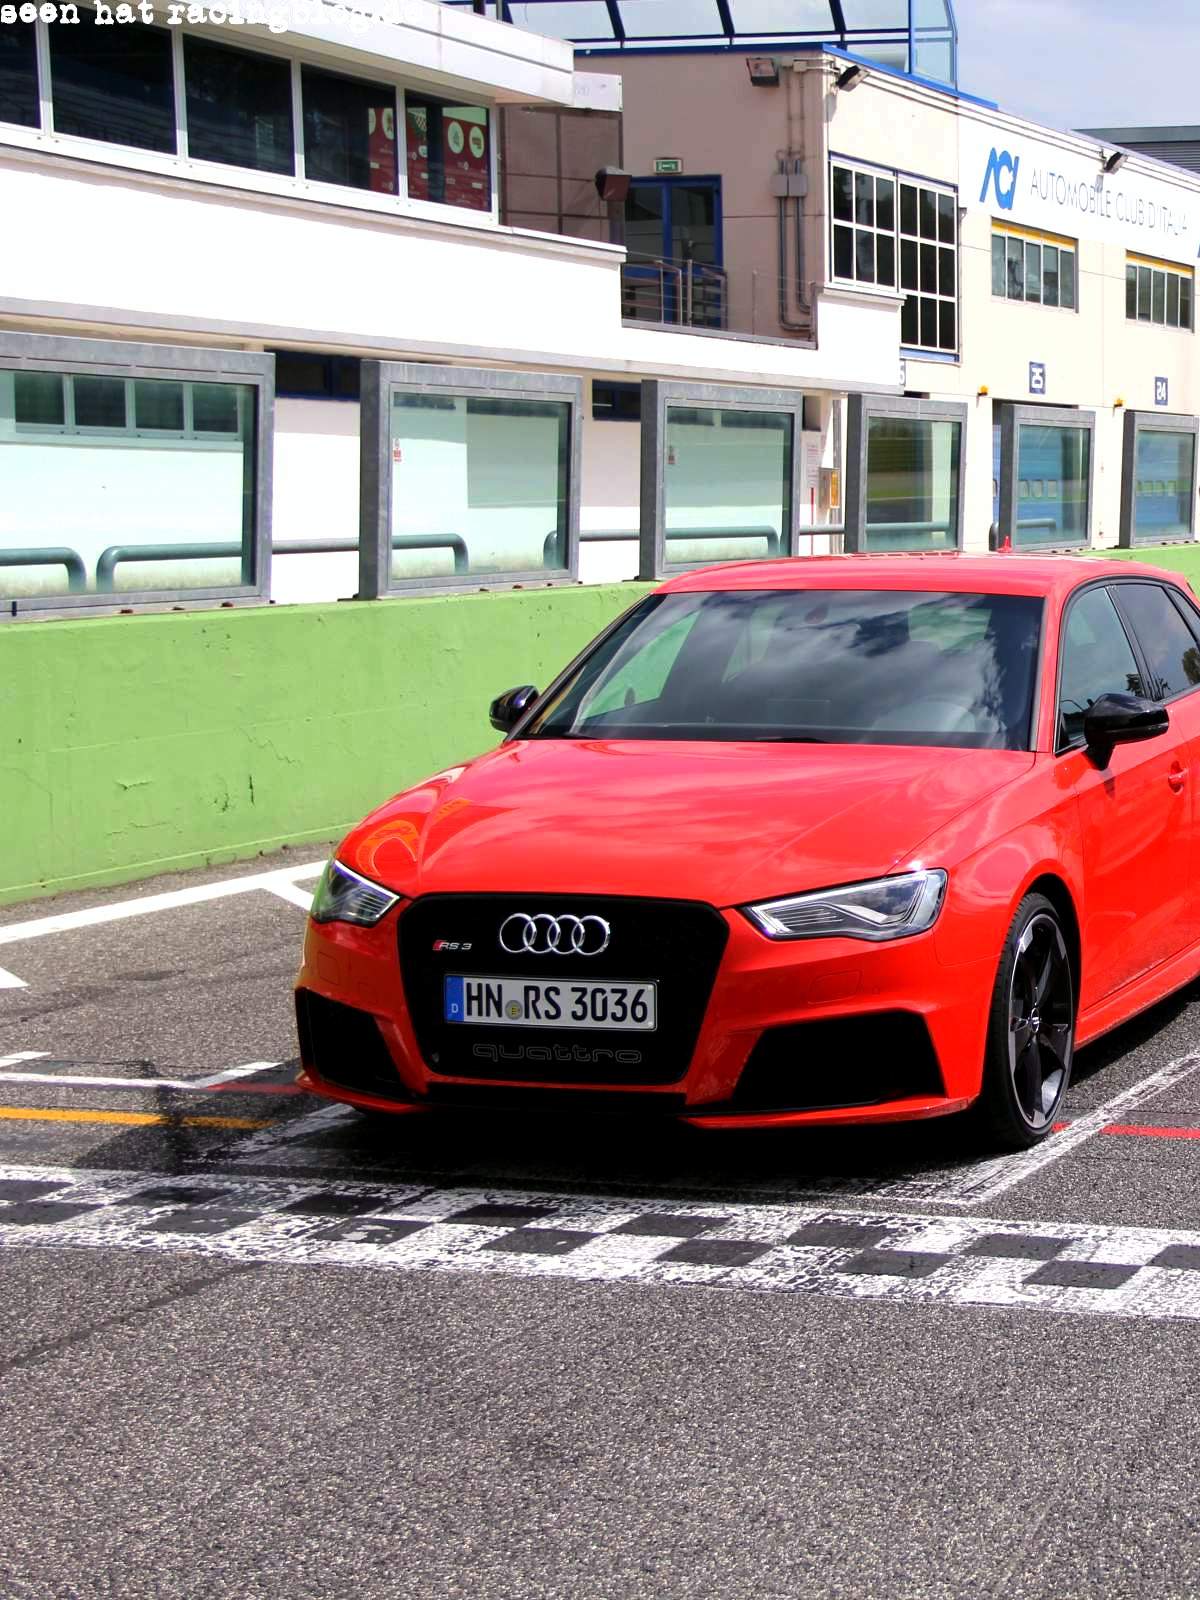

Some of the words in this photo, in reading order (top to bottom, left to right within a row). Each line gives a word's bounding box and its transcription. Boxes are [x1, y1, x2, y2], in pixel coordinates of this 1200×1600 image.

[979, 147, 1020, 210] ACI
[1030, 168, 1112, 218] AUTOMOBILE
[1115, 192, 1145, 228] CLUB
[450, 1003, 460, 1014] D
[465, 982, 503, 1018] HN
[523, 985, 562, 1020] RS
[570, 986, 649, 1024] 3036
[472, 1043, 643, 1064] quattro
